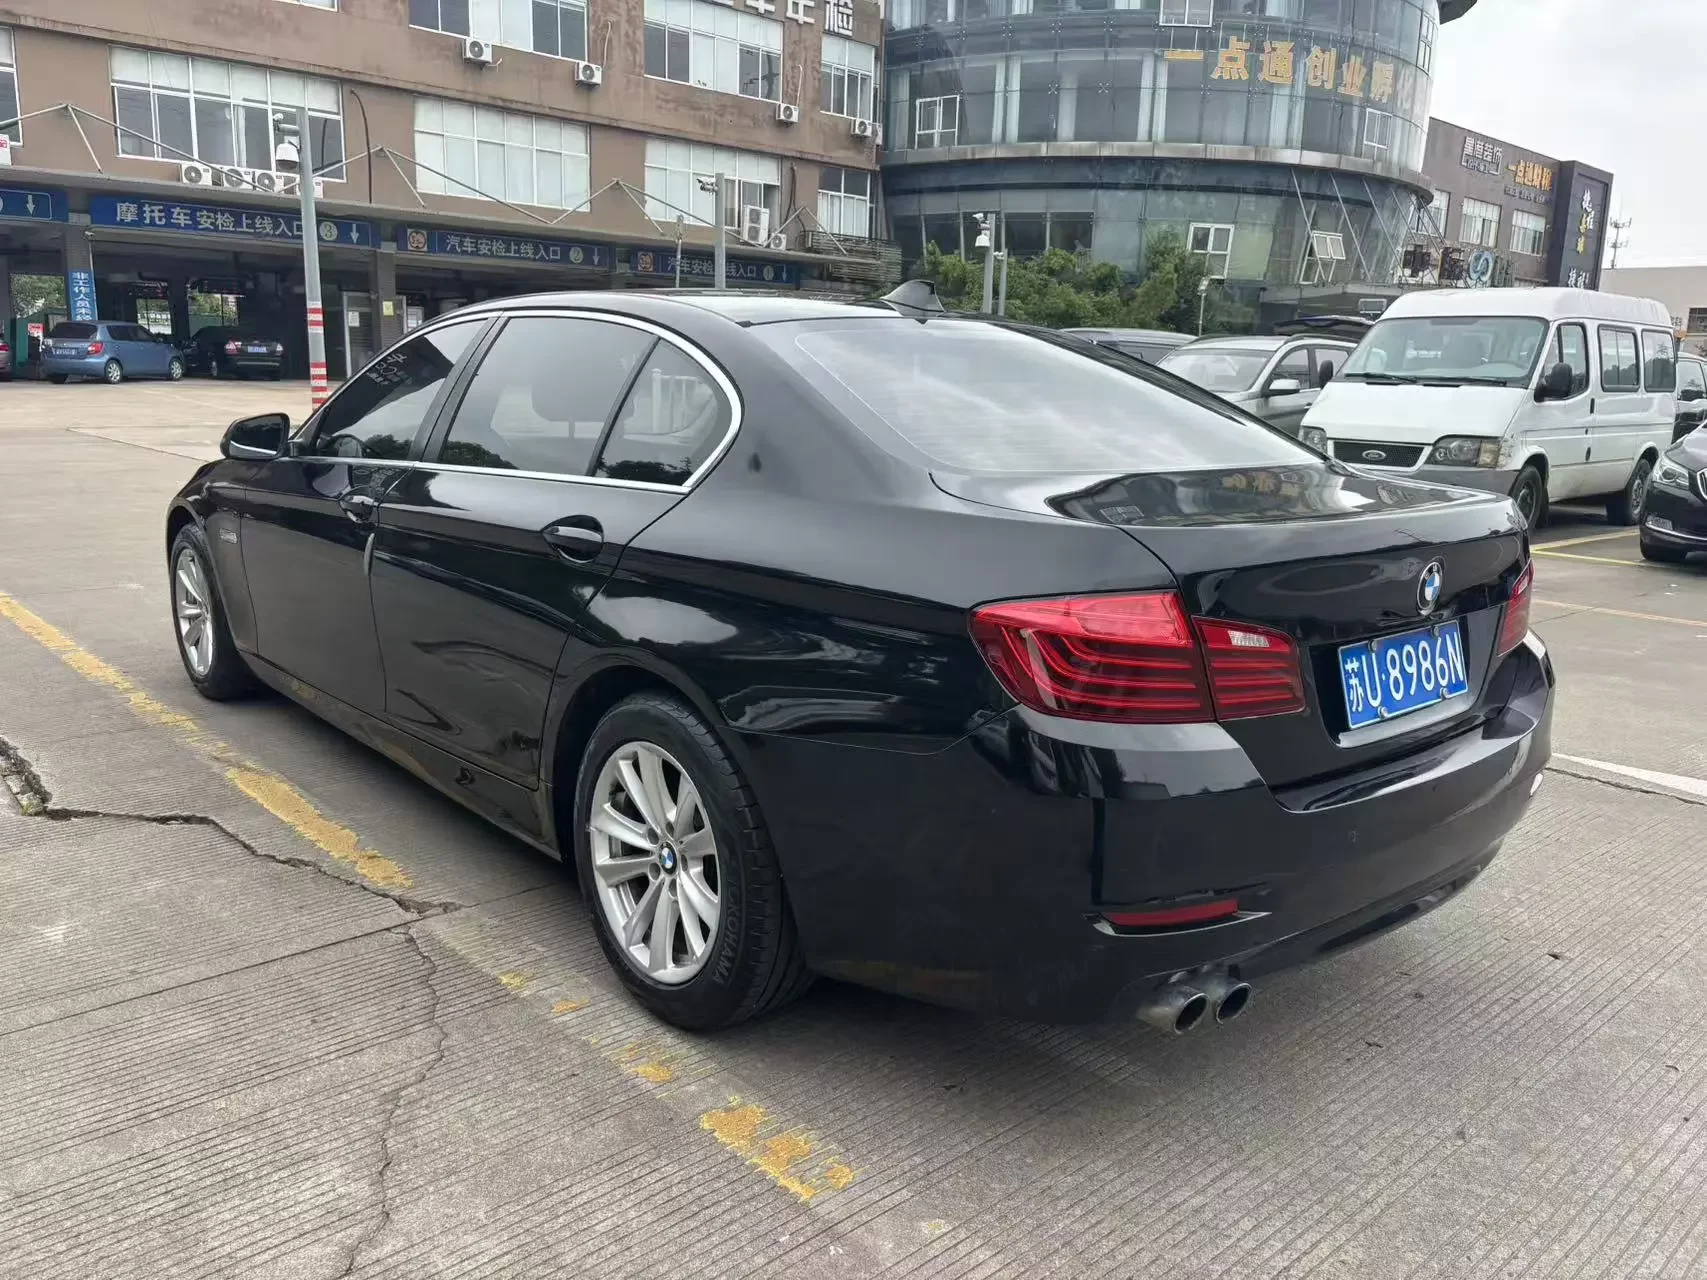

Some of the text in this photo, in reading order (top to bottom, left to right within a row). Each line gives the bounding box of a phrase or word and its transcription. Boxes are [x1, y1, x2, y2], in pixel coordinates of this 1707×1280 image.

[116, 202, 303, 236] 摩托车安检上线入口
[446, 234, 561, 261] 汽车安检上线入口
[668, 257, 757, 277] 汽车安检线入口
